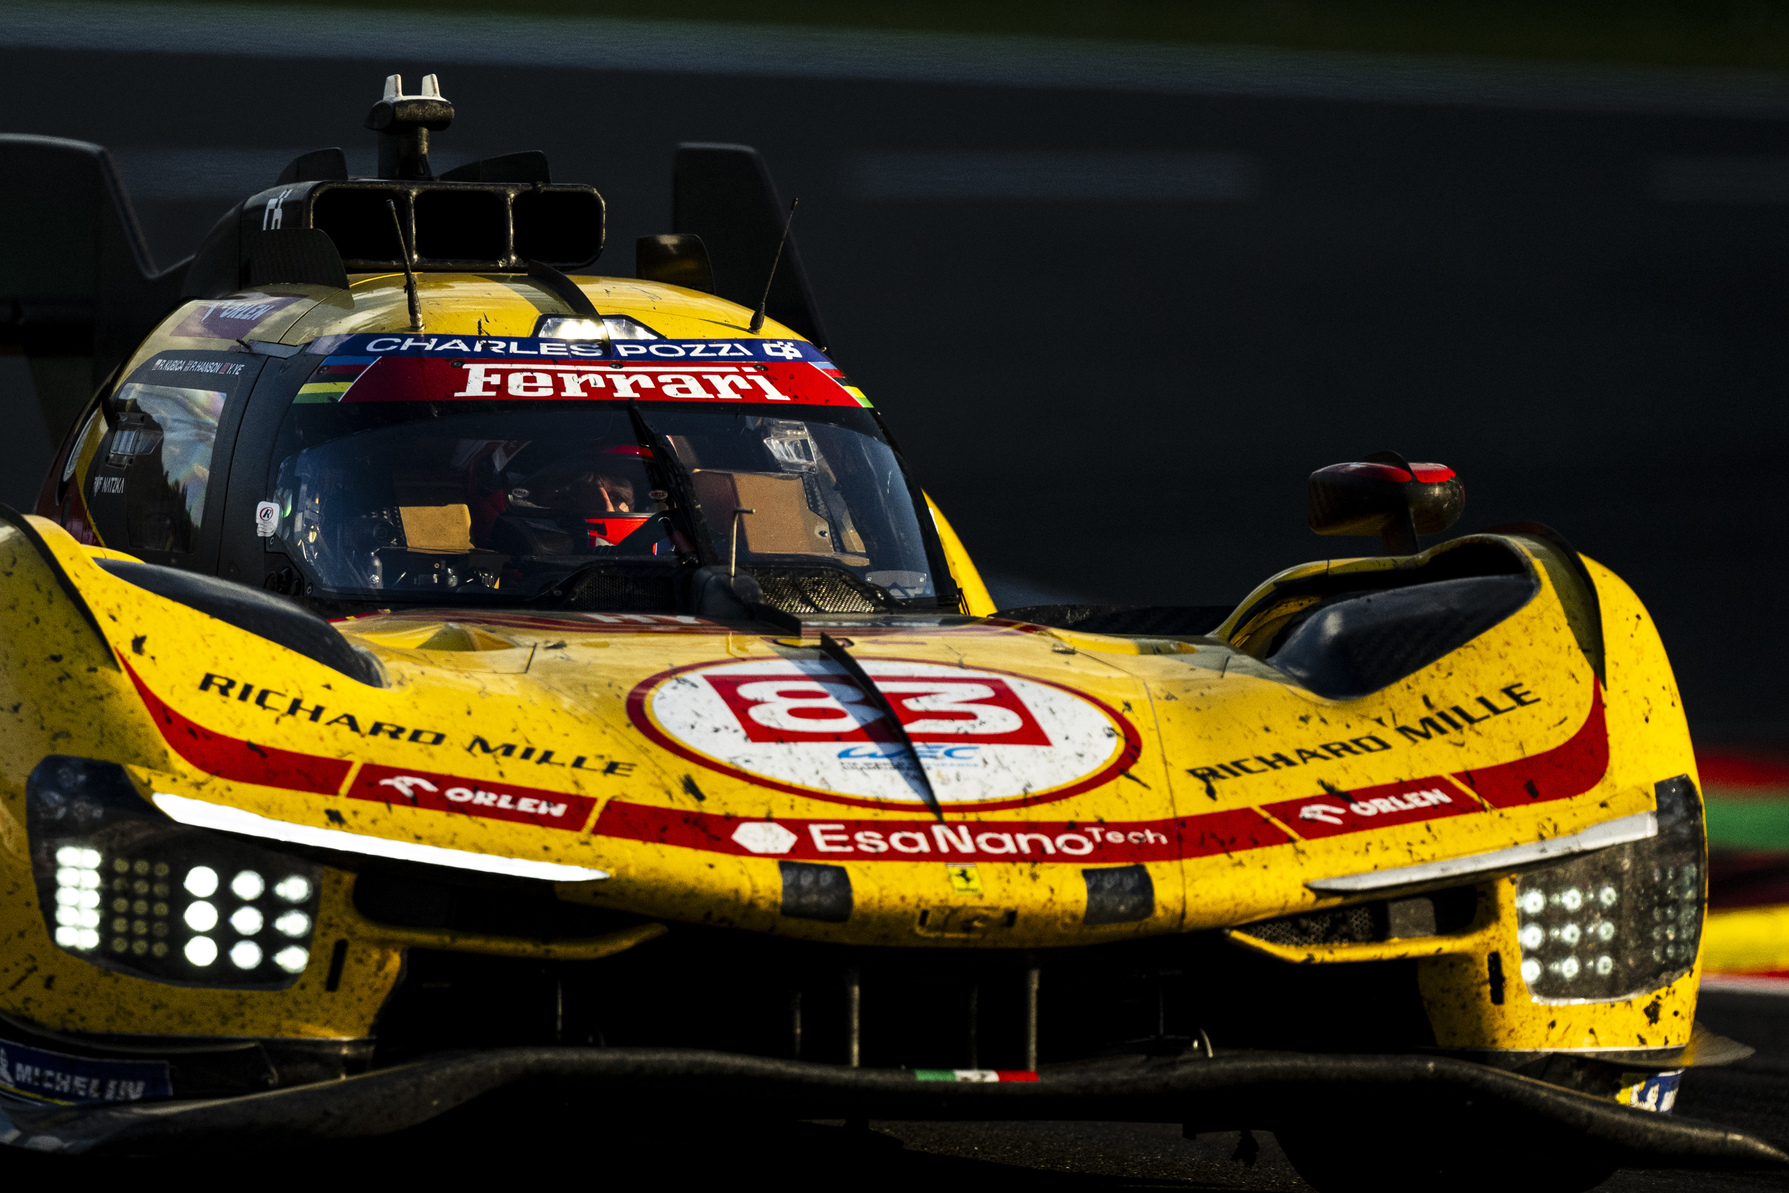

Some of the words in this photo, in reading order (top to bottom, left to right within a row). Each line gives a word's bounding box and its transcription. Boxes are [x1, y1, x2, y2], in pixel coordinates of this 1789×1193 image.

[366, 337, 603, 357] CHARLES
[615, 343, 753, 358] POZZI
[453, 363, 791, 401] Ferrari
[199, 672, 446, 746] RICHARD
[466, 735, 638, 778] MILLE
[733, 680, 1024, 735] 83
[1186, 735, 1393, 781] RICHARD
[1395, 682, 1542, 744] MILLE
[444, 786, 568, 818] ORLEN
[1350, 788, 1453, 817] ORLEN
[14, 1062, 146, 1101] MICHELIN
